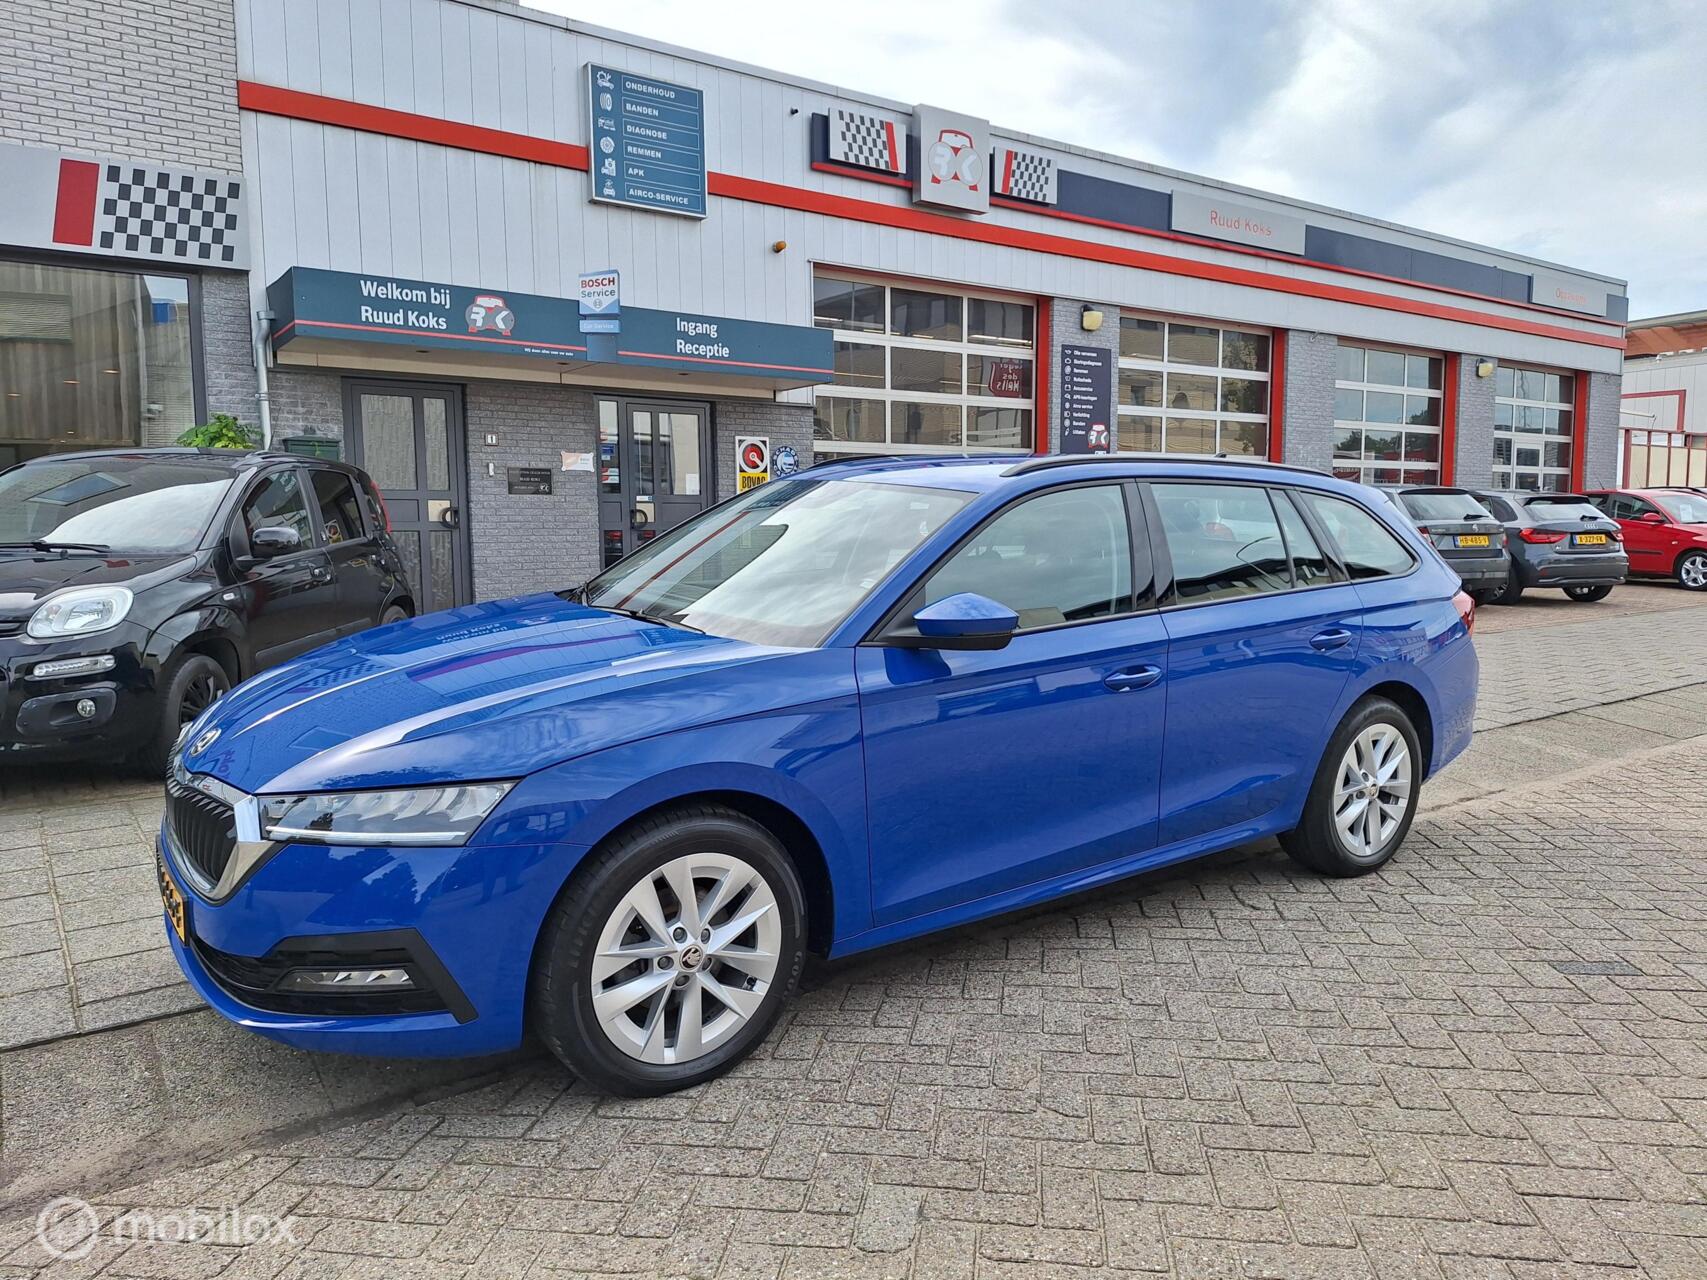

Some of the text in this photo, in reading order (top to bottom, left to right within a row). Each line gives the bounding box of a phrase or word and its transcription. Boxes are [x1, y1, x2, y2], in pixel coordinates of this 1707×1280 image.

[625, 80, 676, 99] ONDERHOUD
[625, 102, 659, 117] BANDEN
[626, 124, 668, 140] DIAGNOSE
[627, 145, 662, 159] REMMEN
[627, 167, 645, 177] APK
[629, 188, 689, 205] AIRCO-SERVICE
[1210, 209, 1272, 237] Ruud Koks
[581, 276, 616, 289] BOSCH
[359, 279, 450, 309] Welkom bij
[581, 289, 616, 299] Service
[360, 305, 448, 330] Ruud Koks
[676, 317, 718, 339] Ingang
[676, 339, 730, 360] Receptie
